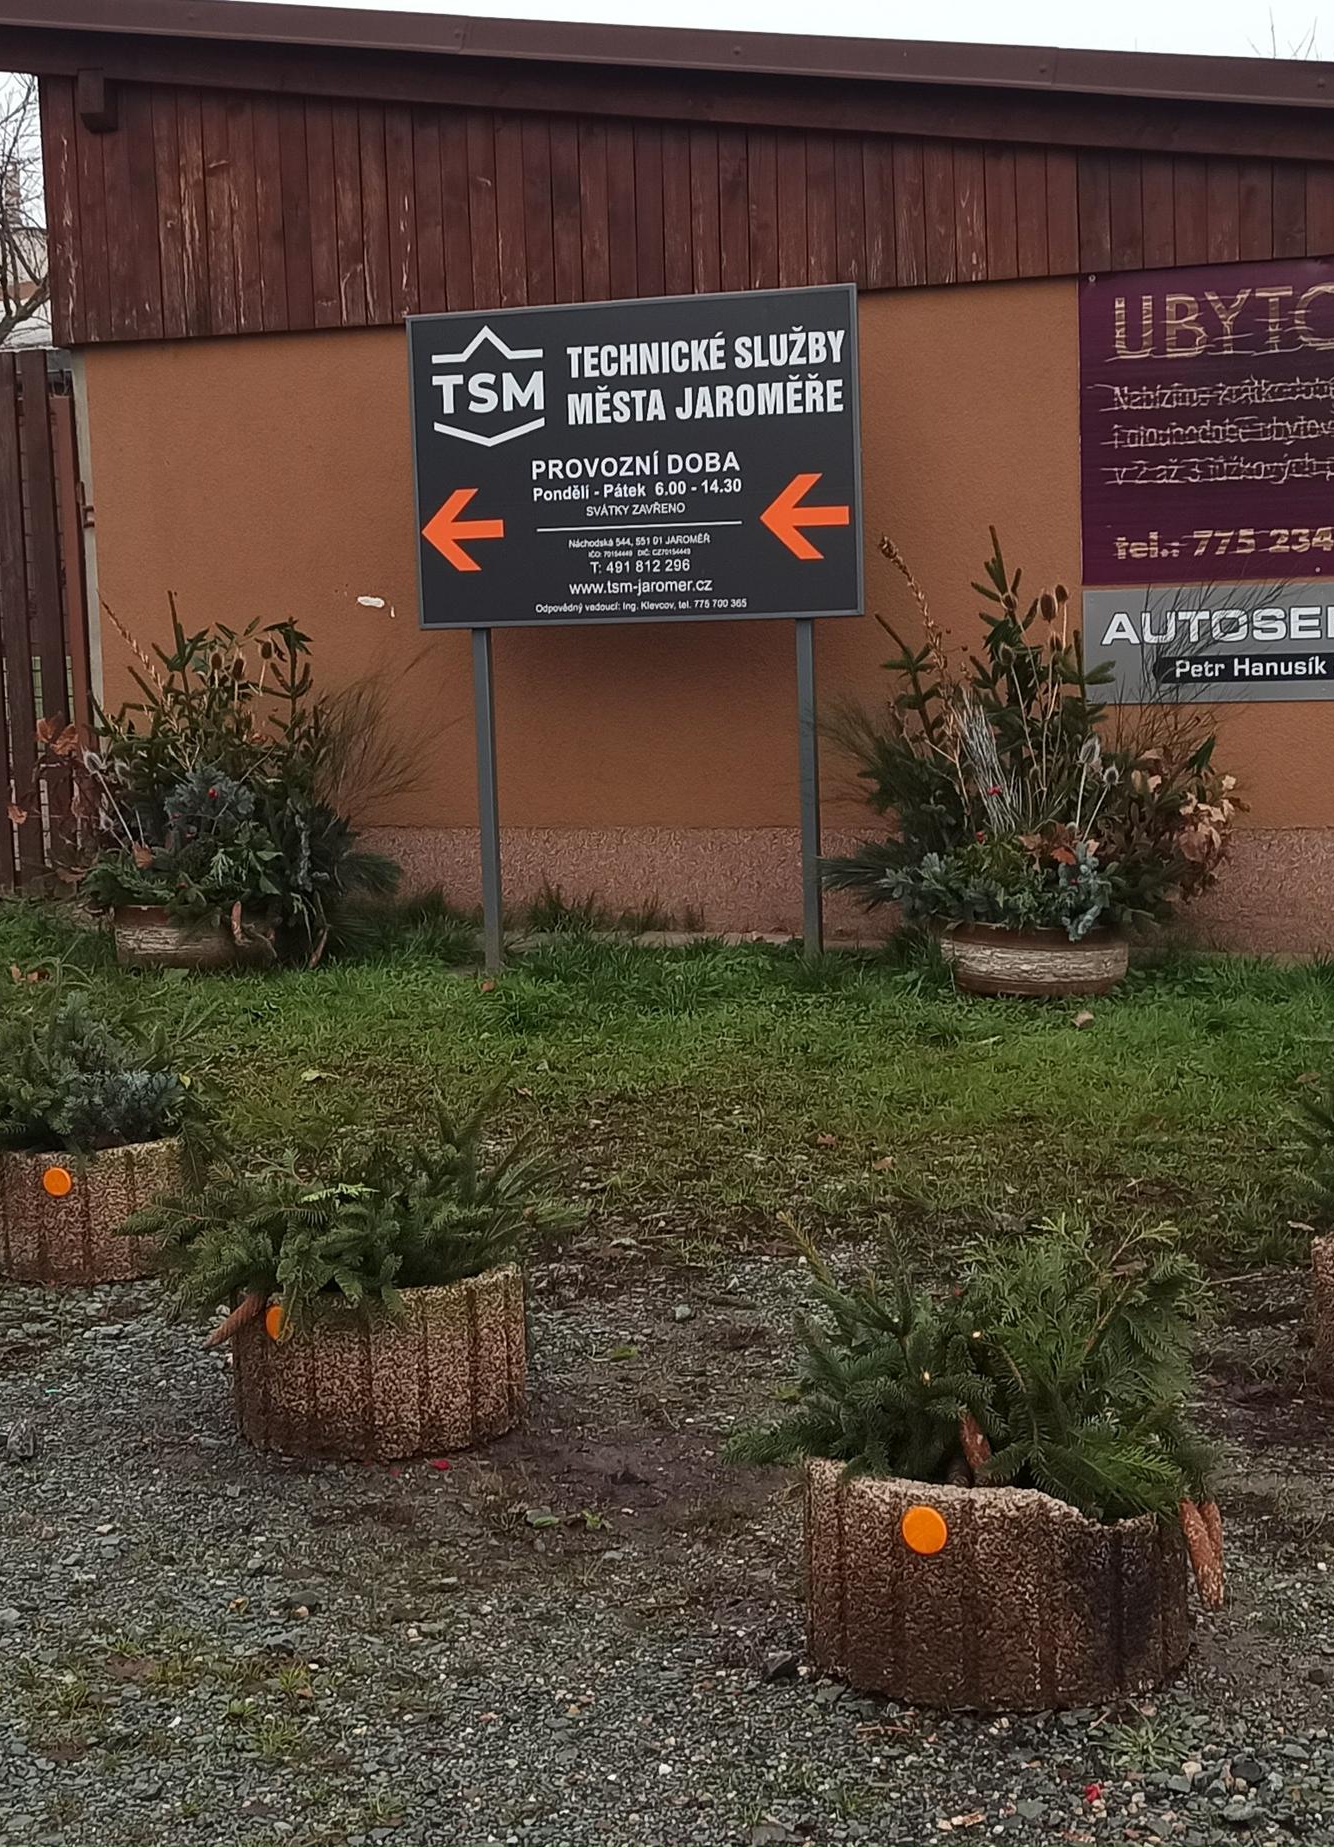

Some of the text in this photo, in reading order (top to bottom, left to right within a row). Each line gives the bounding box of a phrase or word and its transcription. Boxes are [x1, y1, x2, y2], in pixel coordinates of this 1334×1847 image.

[567, 326, 845, 378] TECHNICKÉ SLUŽBY
[432, 371, 545, 415] TSM
[567, 373, 844, 425] MĚSTA JAROMĚŘE
[532, 451, 740, 480] PROVOZNÍ DOBA
[533, 485, 589, 501] Pondělí
[603, 483, 646, 498] Pátek
[655, 481, 686, 496] 6.00
[701, 478, 742, 493] 14.30
[586, 502, 686, 516] SVÁTKY ZAVŘENO
[568, 537, 613, 549] Náchodská
[635, 536, 650, 546] 551
[653, 535, 663, 545] 01
[665, 532, 711, 545] JAROMĚŘ
[1192, 528, 1256, 557] 775
[1269, 525, 1334, 553] 234
[590, 559, 690, 574] T: 491 812 296
[569, 579, 713, 596] www.tsm-jaromer.cz
[535, 602, 582, 614] Odpovědný
[623, 601, 638, 612] Ing.
[678, 600, 691, 610] tel.
[712, 599, 728, 608] 700
[731, 599, 747, 608] 365
[1174, 659, 1226, 679] Petr
[1233, 654, 1326, 678] Hanusík
